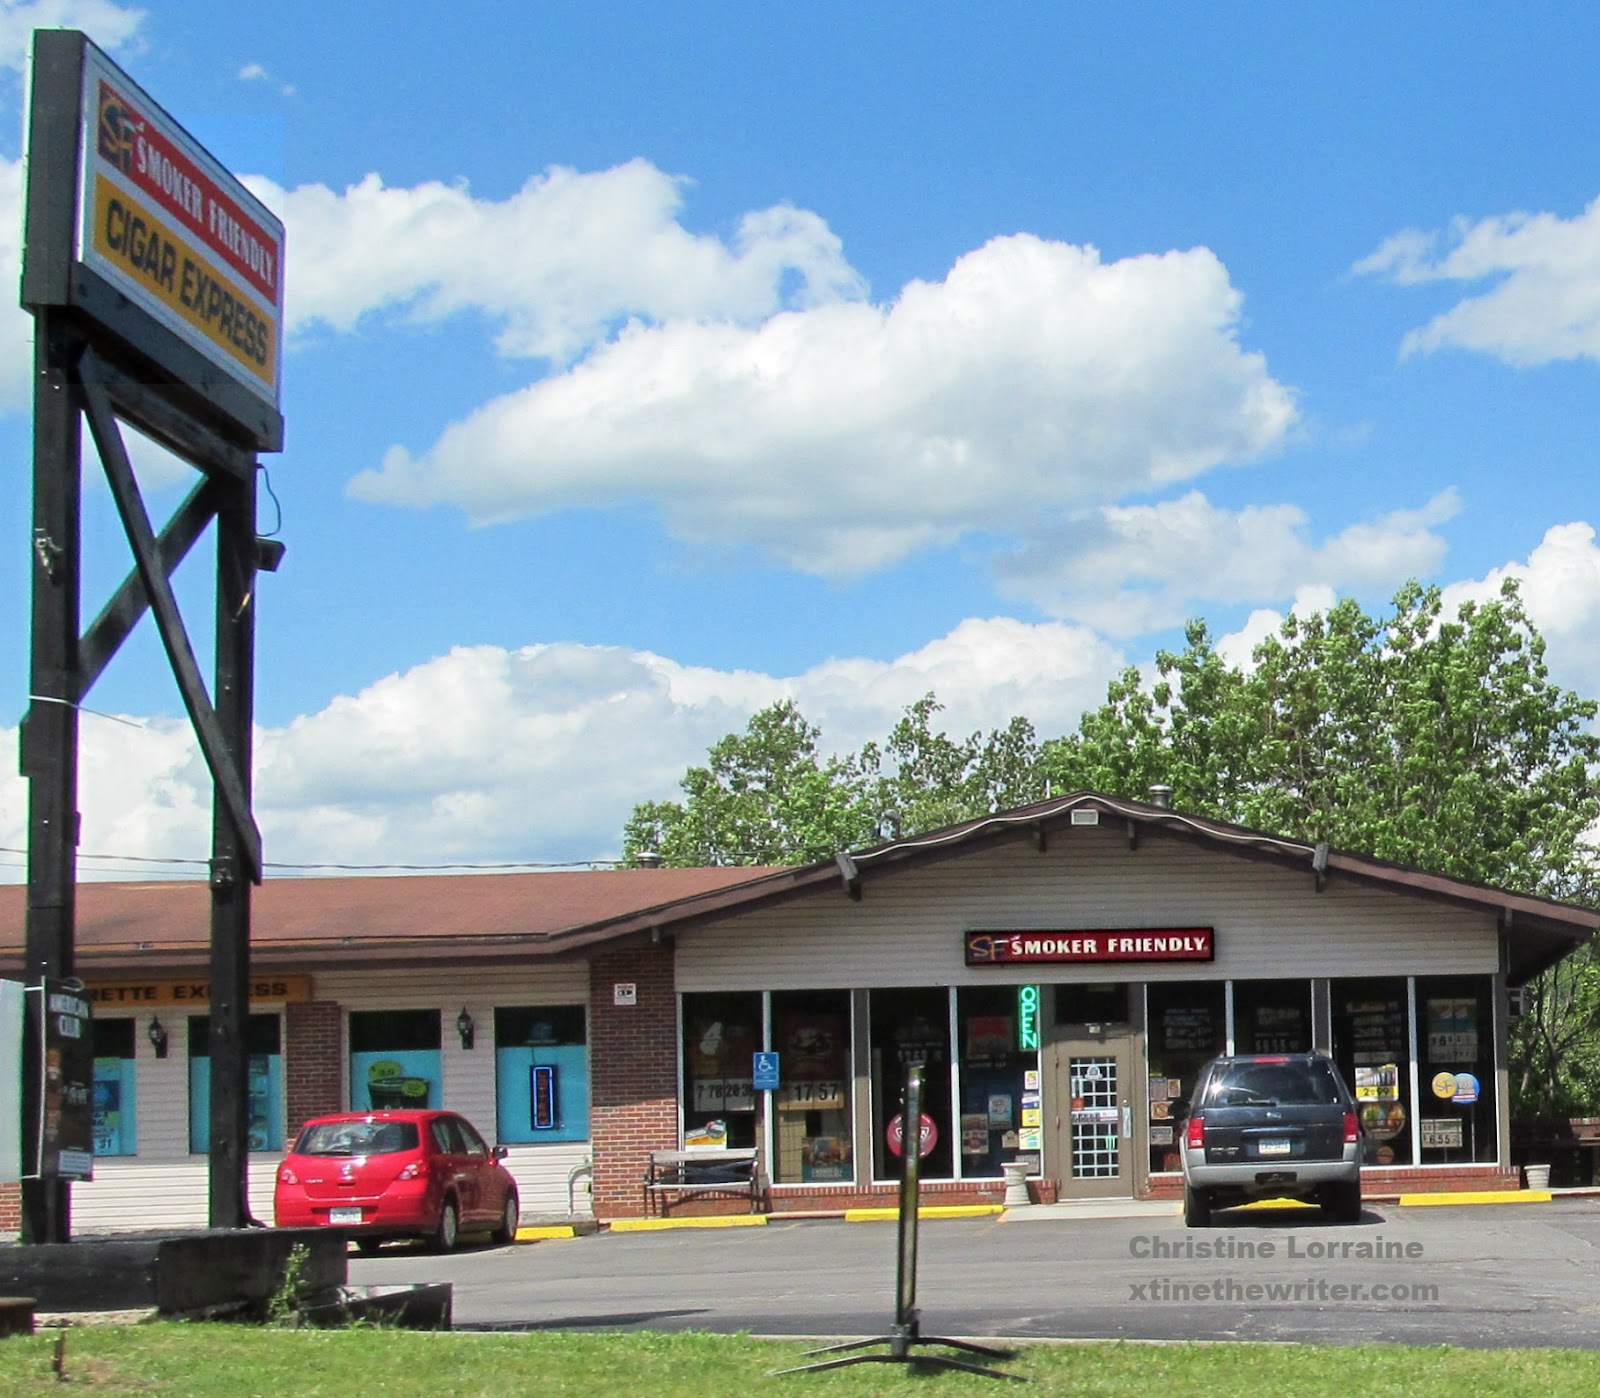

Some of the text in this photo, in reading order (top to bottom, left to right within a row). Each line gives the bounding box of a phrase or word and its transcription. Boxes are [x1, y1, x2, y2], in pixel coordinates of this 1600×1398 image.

[136, 136, 203, 224] SMOKER
[208, 198, 275, 288] FRIENDLY
[105, 198, 267, 367] CIGAR EXPRESS
[1011, 938, 1098, 956] SMOKER
[1107, 936, 1207, 954] FRIENDLY
[1020, 985, 1038, 1049] OPEN
